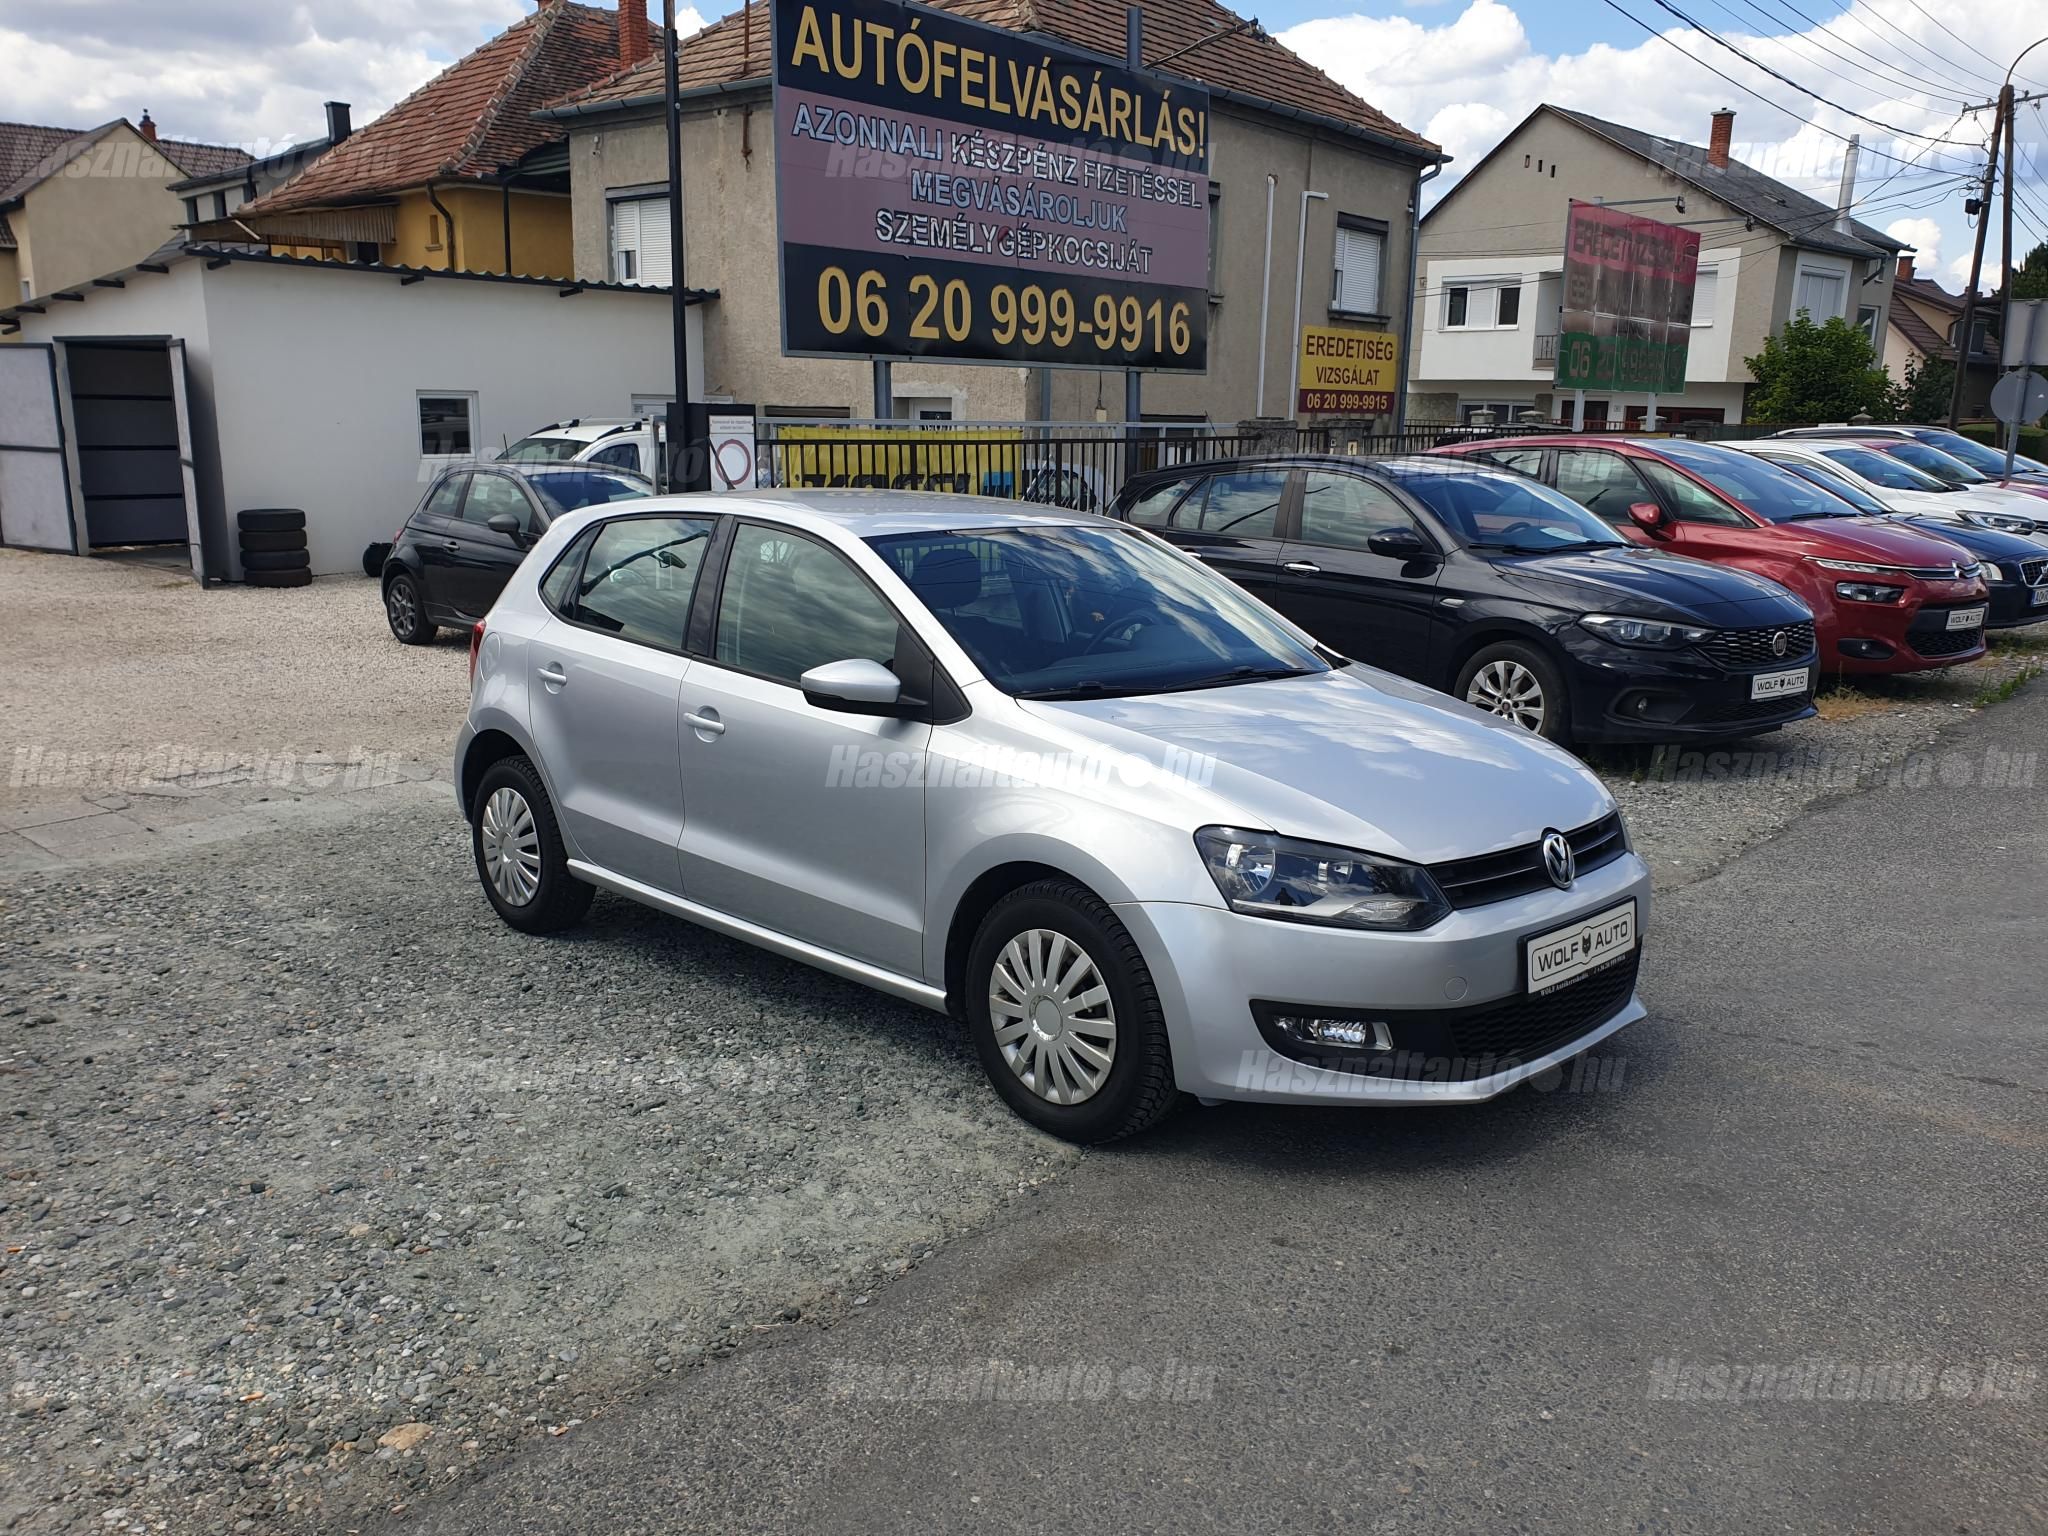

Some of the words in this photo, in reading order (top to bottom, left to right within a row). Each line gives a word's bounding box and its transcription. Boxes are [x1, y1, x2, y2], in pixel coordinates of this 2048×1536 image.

[791, 5, 1205, 159] AUTÓFELVÁSÁRLÁS!
[791, 103, 943, 161] AZONNALI
[950, 131, 1078, 186] KÉSZPÉNZ
[1084, 160, 1203, 209] FIZETÉSSEL
[911, 168, 1127, 233] MEGVÁSÁROLJUK
[876, 208, 1152, 274] SZEMÉLYGÉPKOCSIJÁT
[818, 265, 889, 337] 06
[908, 274, 972, 343] 20
[990, 284, 1191, 356] 999-9916
[1306, 335, 1393, 361] EREDETISÉG
[1316, 364, 1380, 386] VIZSGÁLAT
[1307, 393, 1320, 408] 06
[1323, 393, 1337, 409] 20
[1340, 394, 1387, 410] 999-9915
[1757, 680, 1778, 691] WOLF
[1787, 675, 1804, 686] AUTO
[1538, 942, 1579, 972] WOLF
[1595, 920, 1628, 950] AUTO
